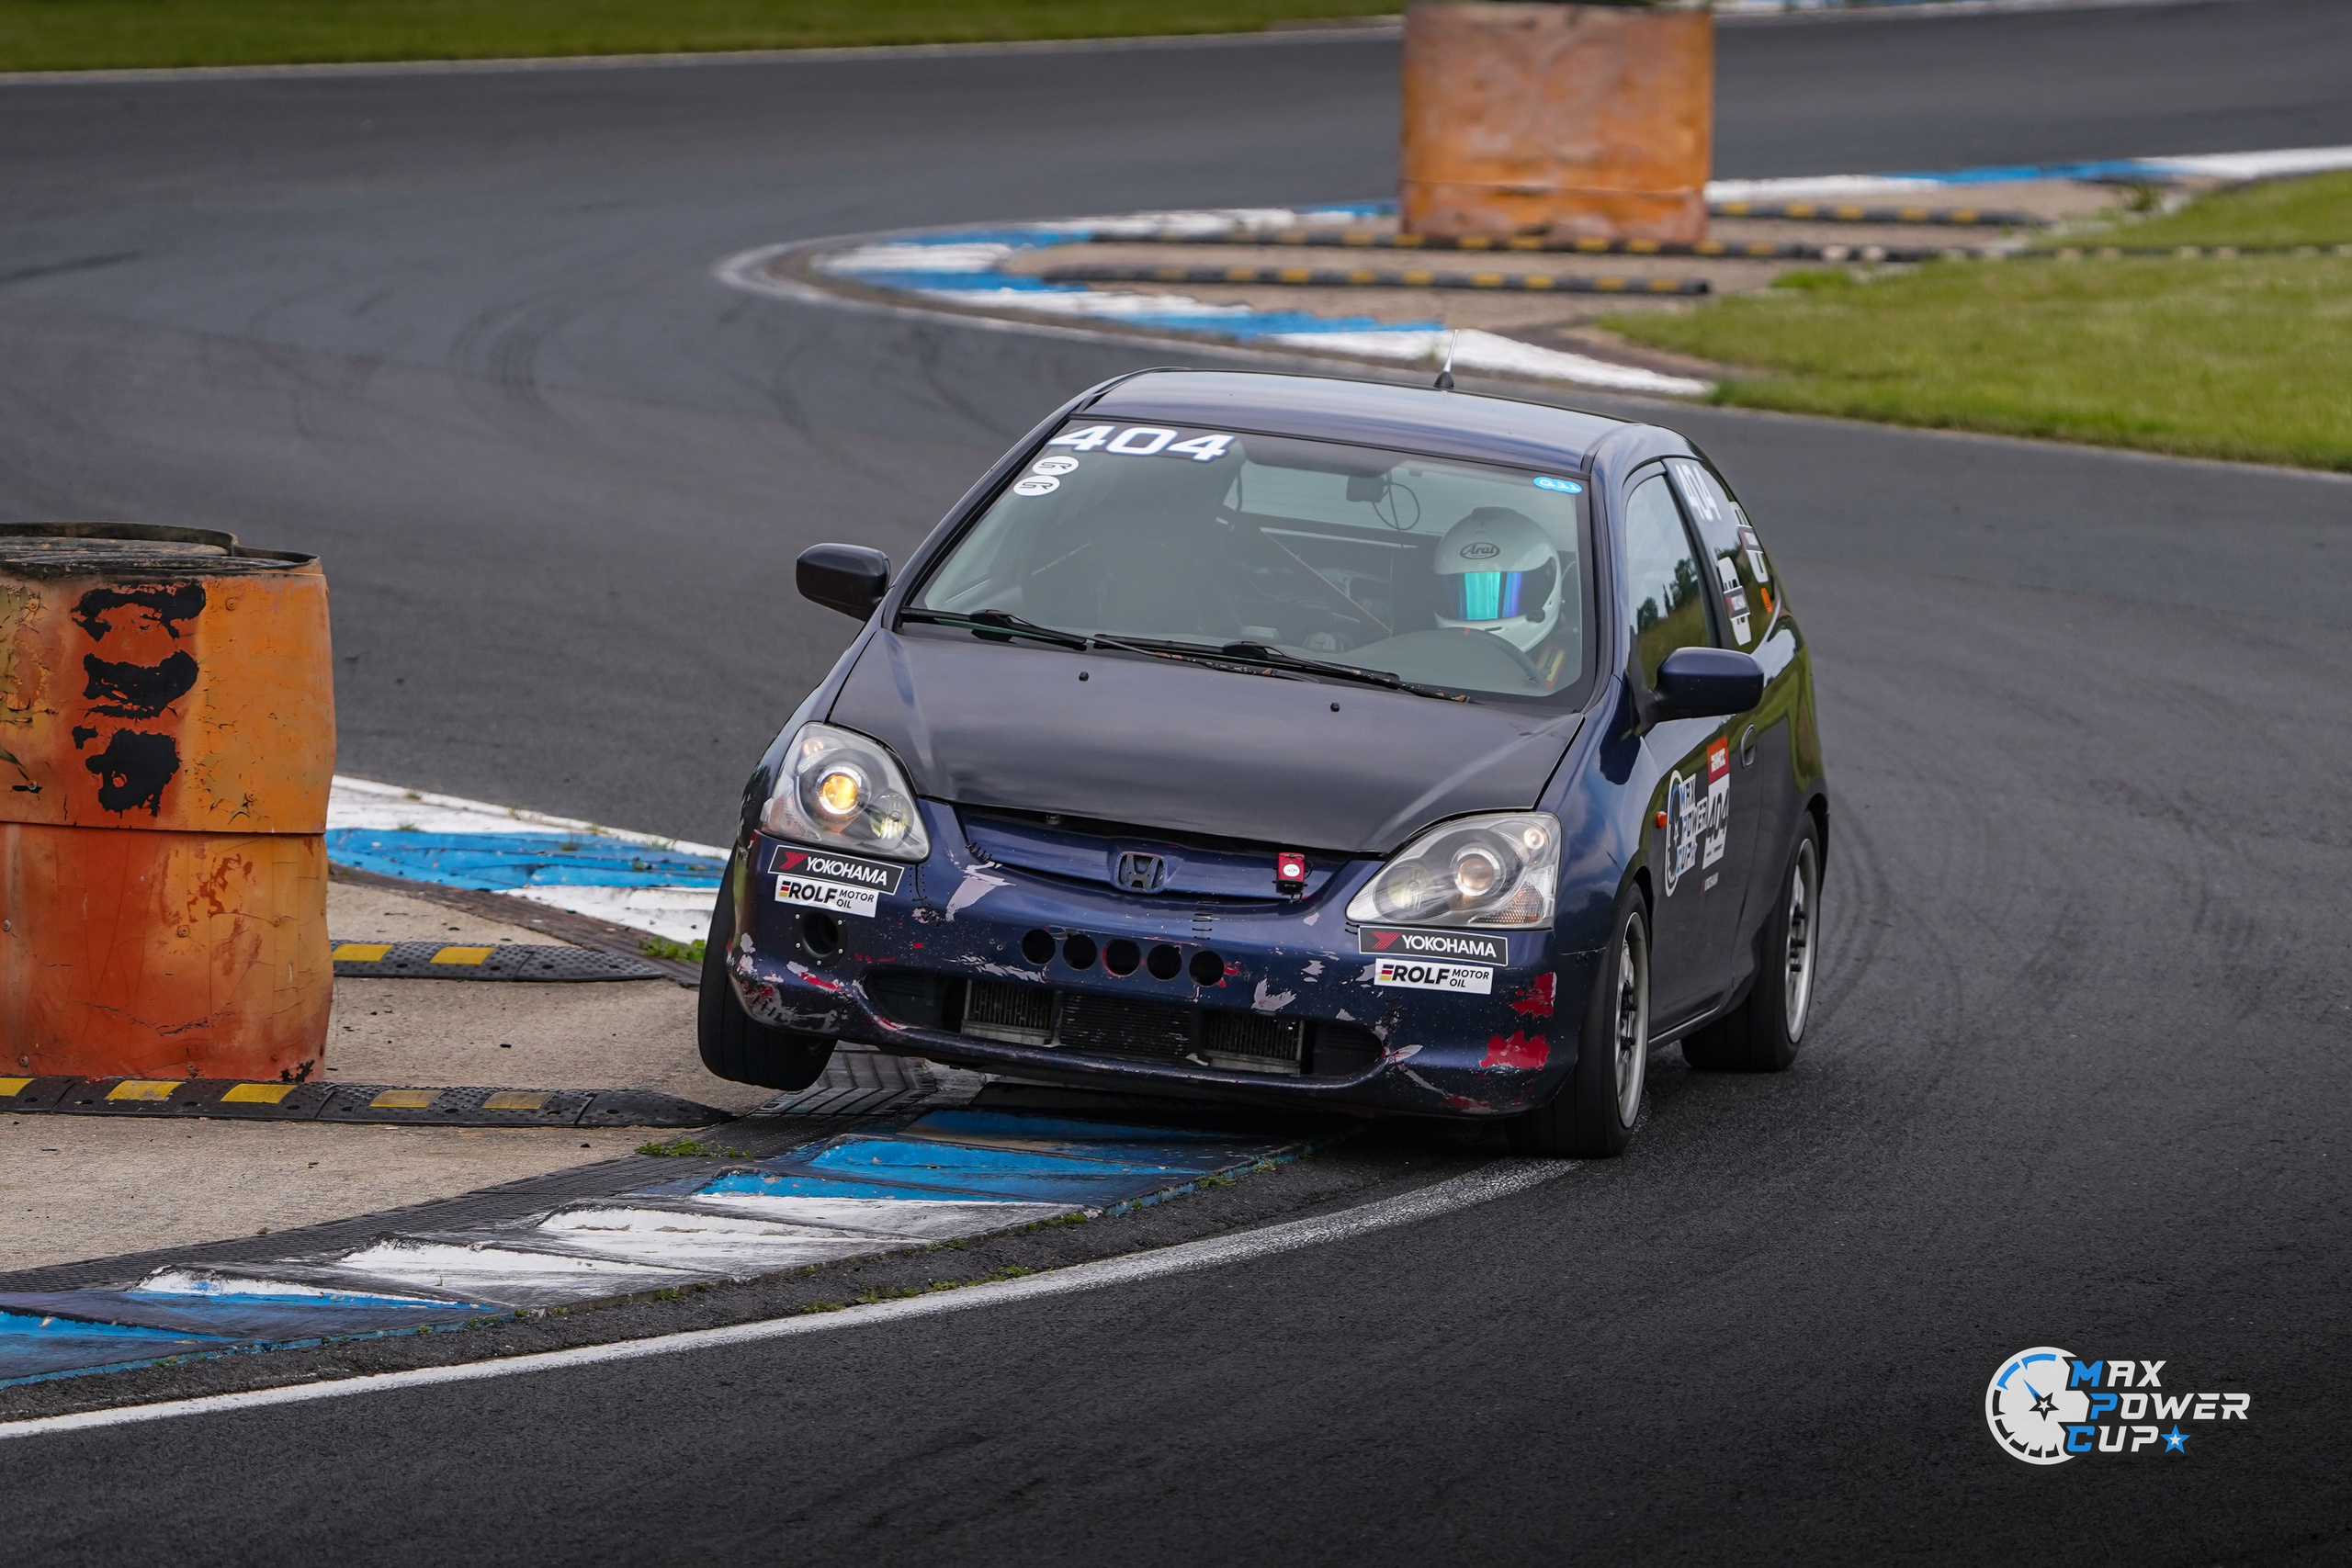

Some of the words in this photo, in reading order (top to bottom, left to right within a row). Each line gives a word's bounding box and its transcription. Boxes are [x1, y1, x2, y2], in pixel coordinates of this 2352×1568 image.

[1047, 425, 1235, 461] 404
[1675, 463, 1723, 522] 404
[1462, 544, 1495, 555] Arai
[1706, 787, 1730, 843] 404
[806, 856, 888, 886] YOKOHAMA
[788, 881, 838, 904] ROLF
[836, 898, 852, 909] OIL
[839, 889, 875, 903] MOTOR
[1401, 934, 1498, 958] YOKOHAMA
[1391, 964, 1451, 985] ROLF
[1449, 978, 1466, 988] OIL
[1452, 968, 1489, 980] MOTOR
